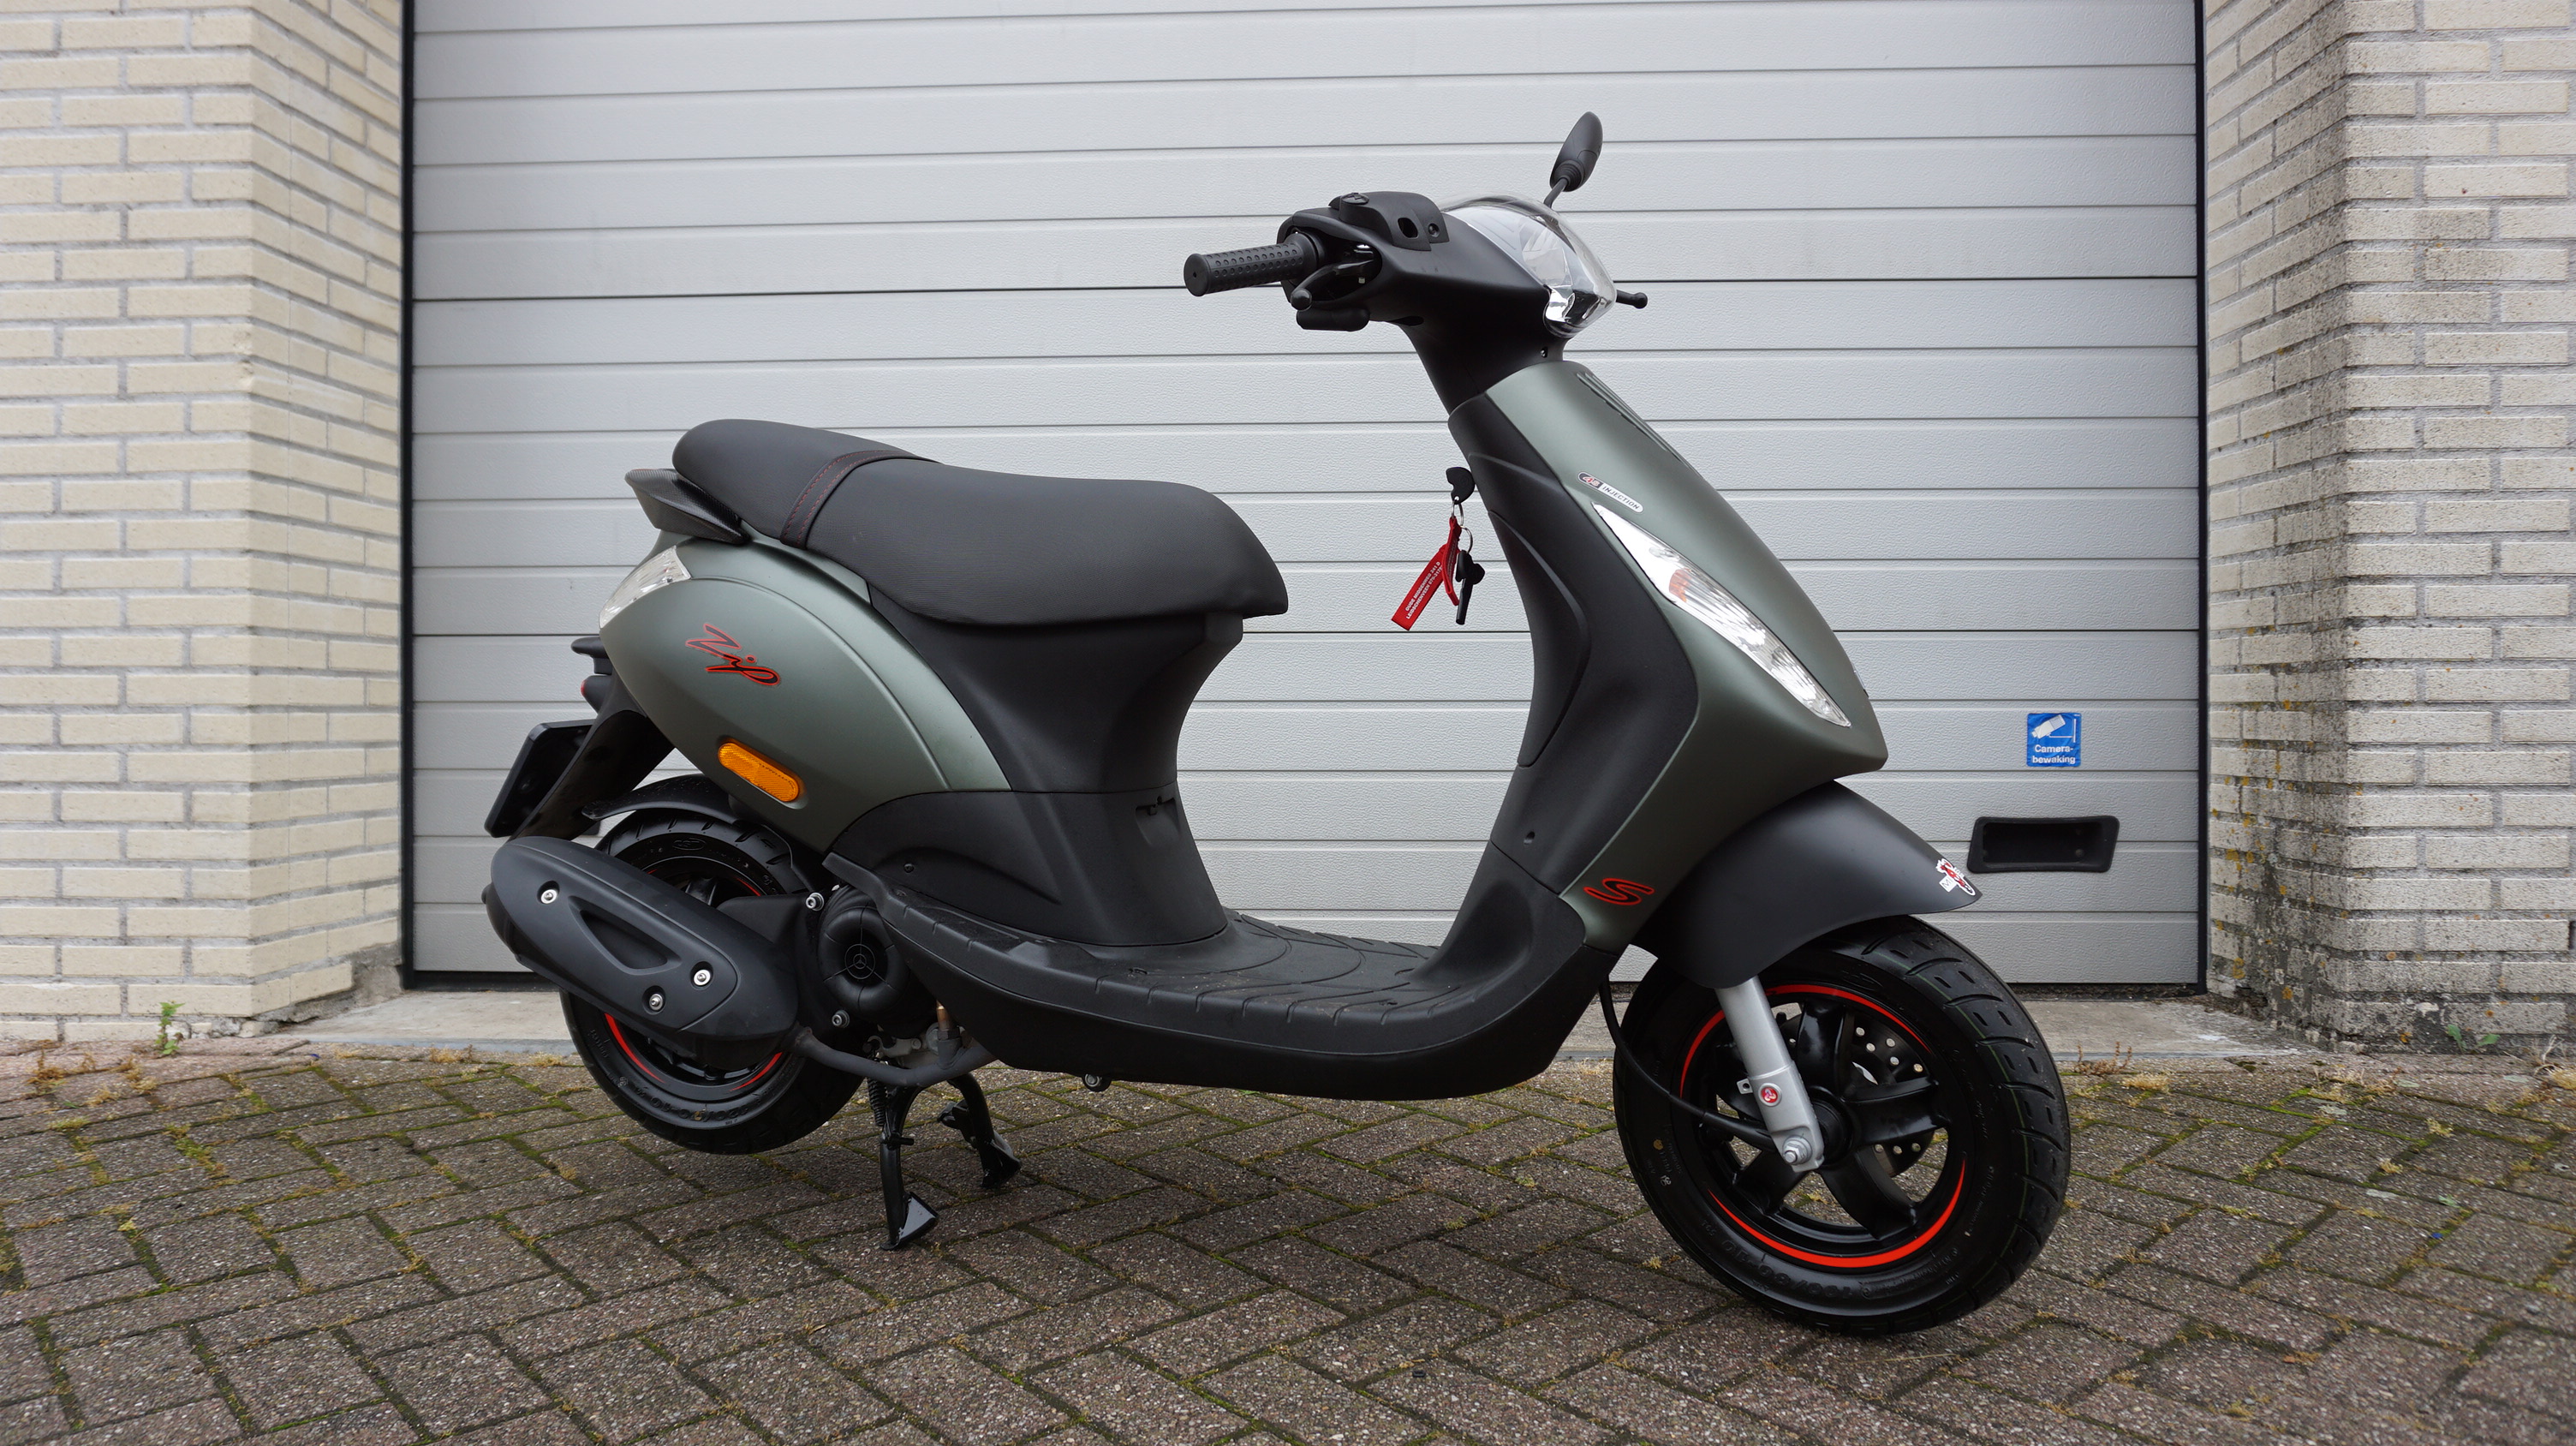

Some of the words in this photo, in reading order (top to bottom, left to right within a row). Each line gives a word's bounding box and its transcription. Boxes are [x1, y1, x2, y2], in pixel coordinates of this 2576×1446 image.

[1602, 485, 1641, 510] INJECTION
[1405, 598, 1415, 611] OUDE
[685, 623, 780, 686] Zip
[2034, 744, 2073, 753] Camera-
[2032, 755, 2076, 764] bewaking
[1583, 877, 1655, 905] S
